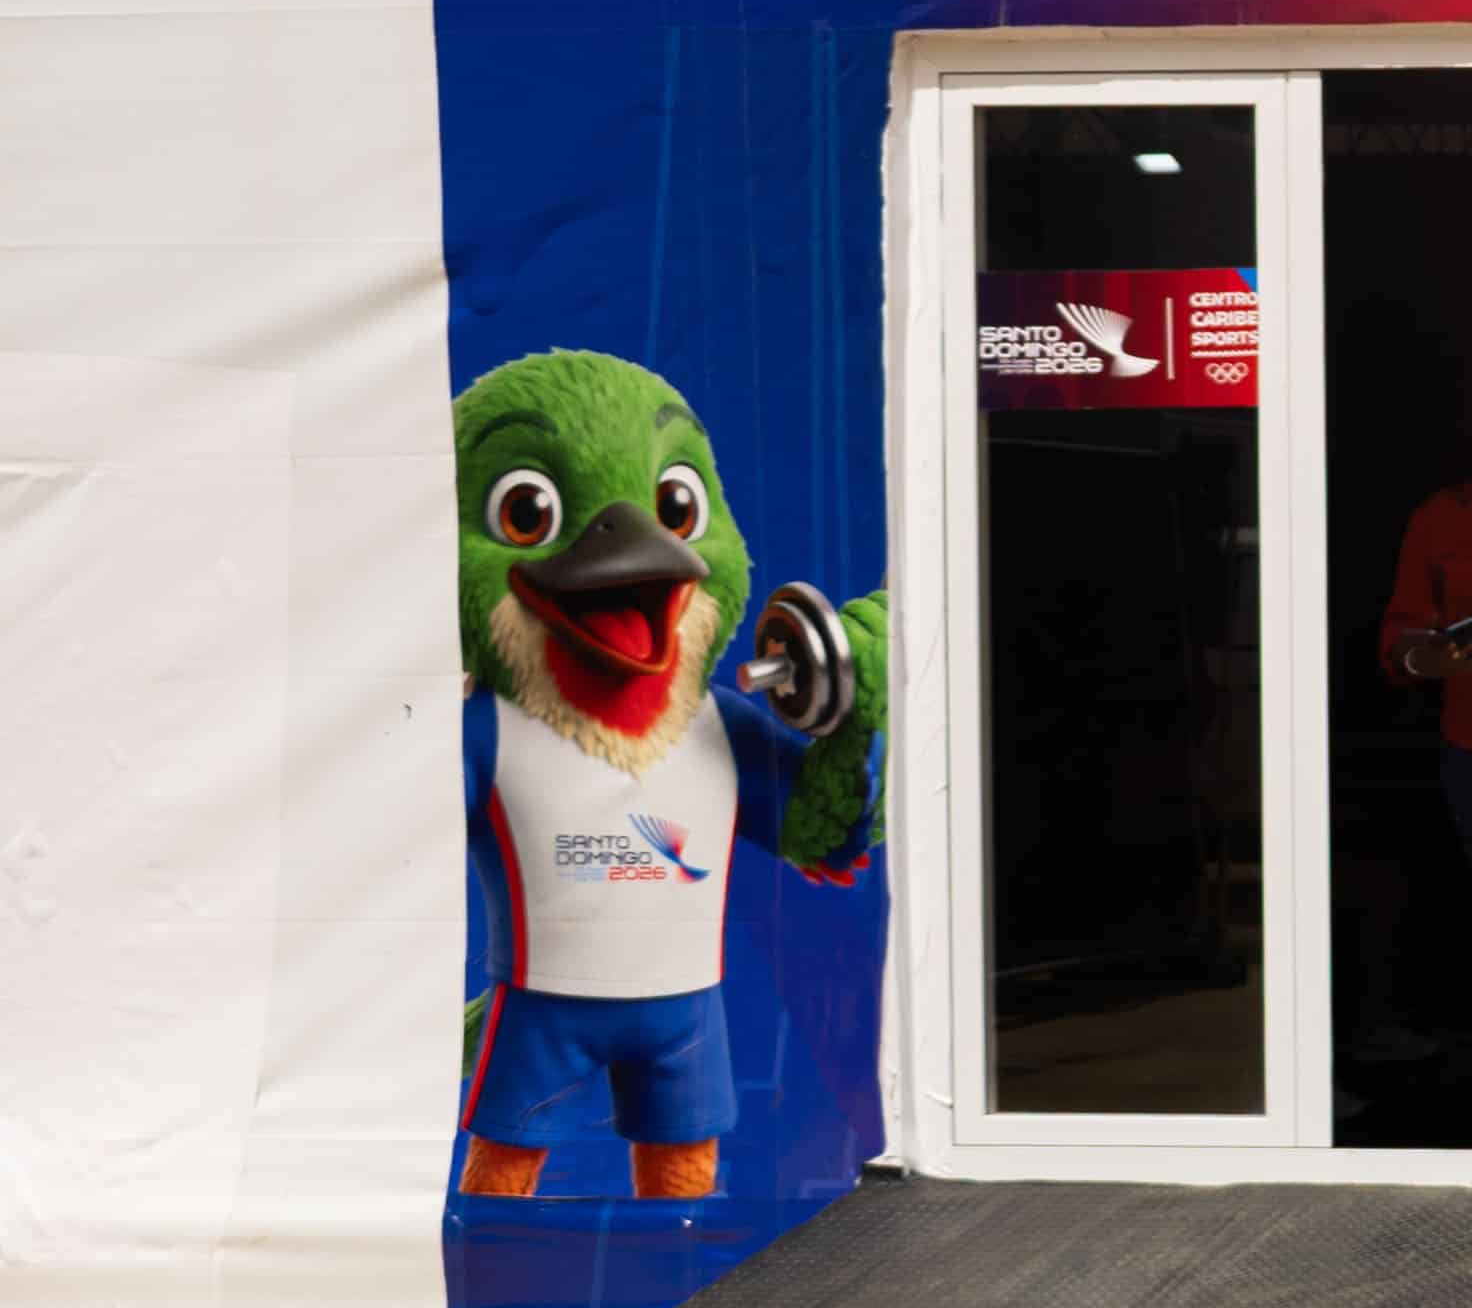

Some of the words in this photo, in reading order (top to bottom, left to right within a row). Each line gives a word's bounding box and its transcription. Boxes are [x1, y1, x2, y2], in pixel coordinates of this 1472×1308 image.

[1190, 292, 1256, 307] CENTRO
[1190, 310, 1258, 327] CARIBE
[979, 326, 1061, 342] SANTO
[1191, 331, 1260, 347] SPORTS
[979, 342, 1086, 358] DOMINGO
[1035, 358, 1104, 374] 2026
[555, 835, 630, 850] SANTO
[555, 851, 653, 866] DOMINGO
[607, 866, 666, 881] 2026
